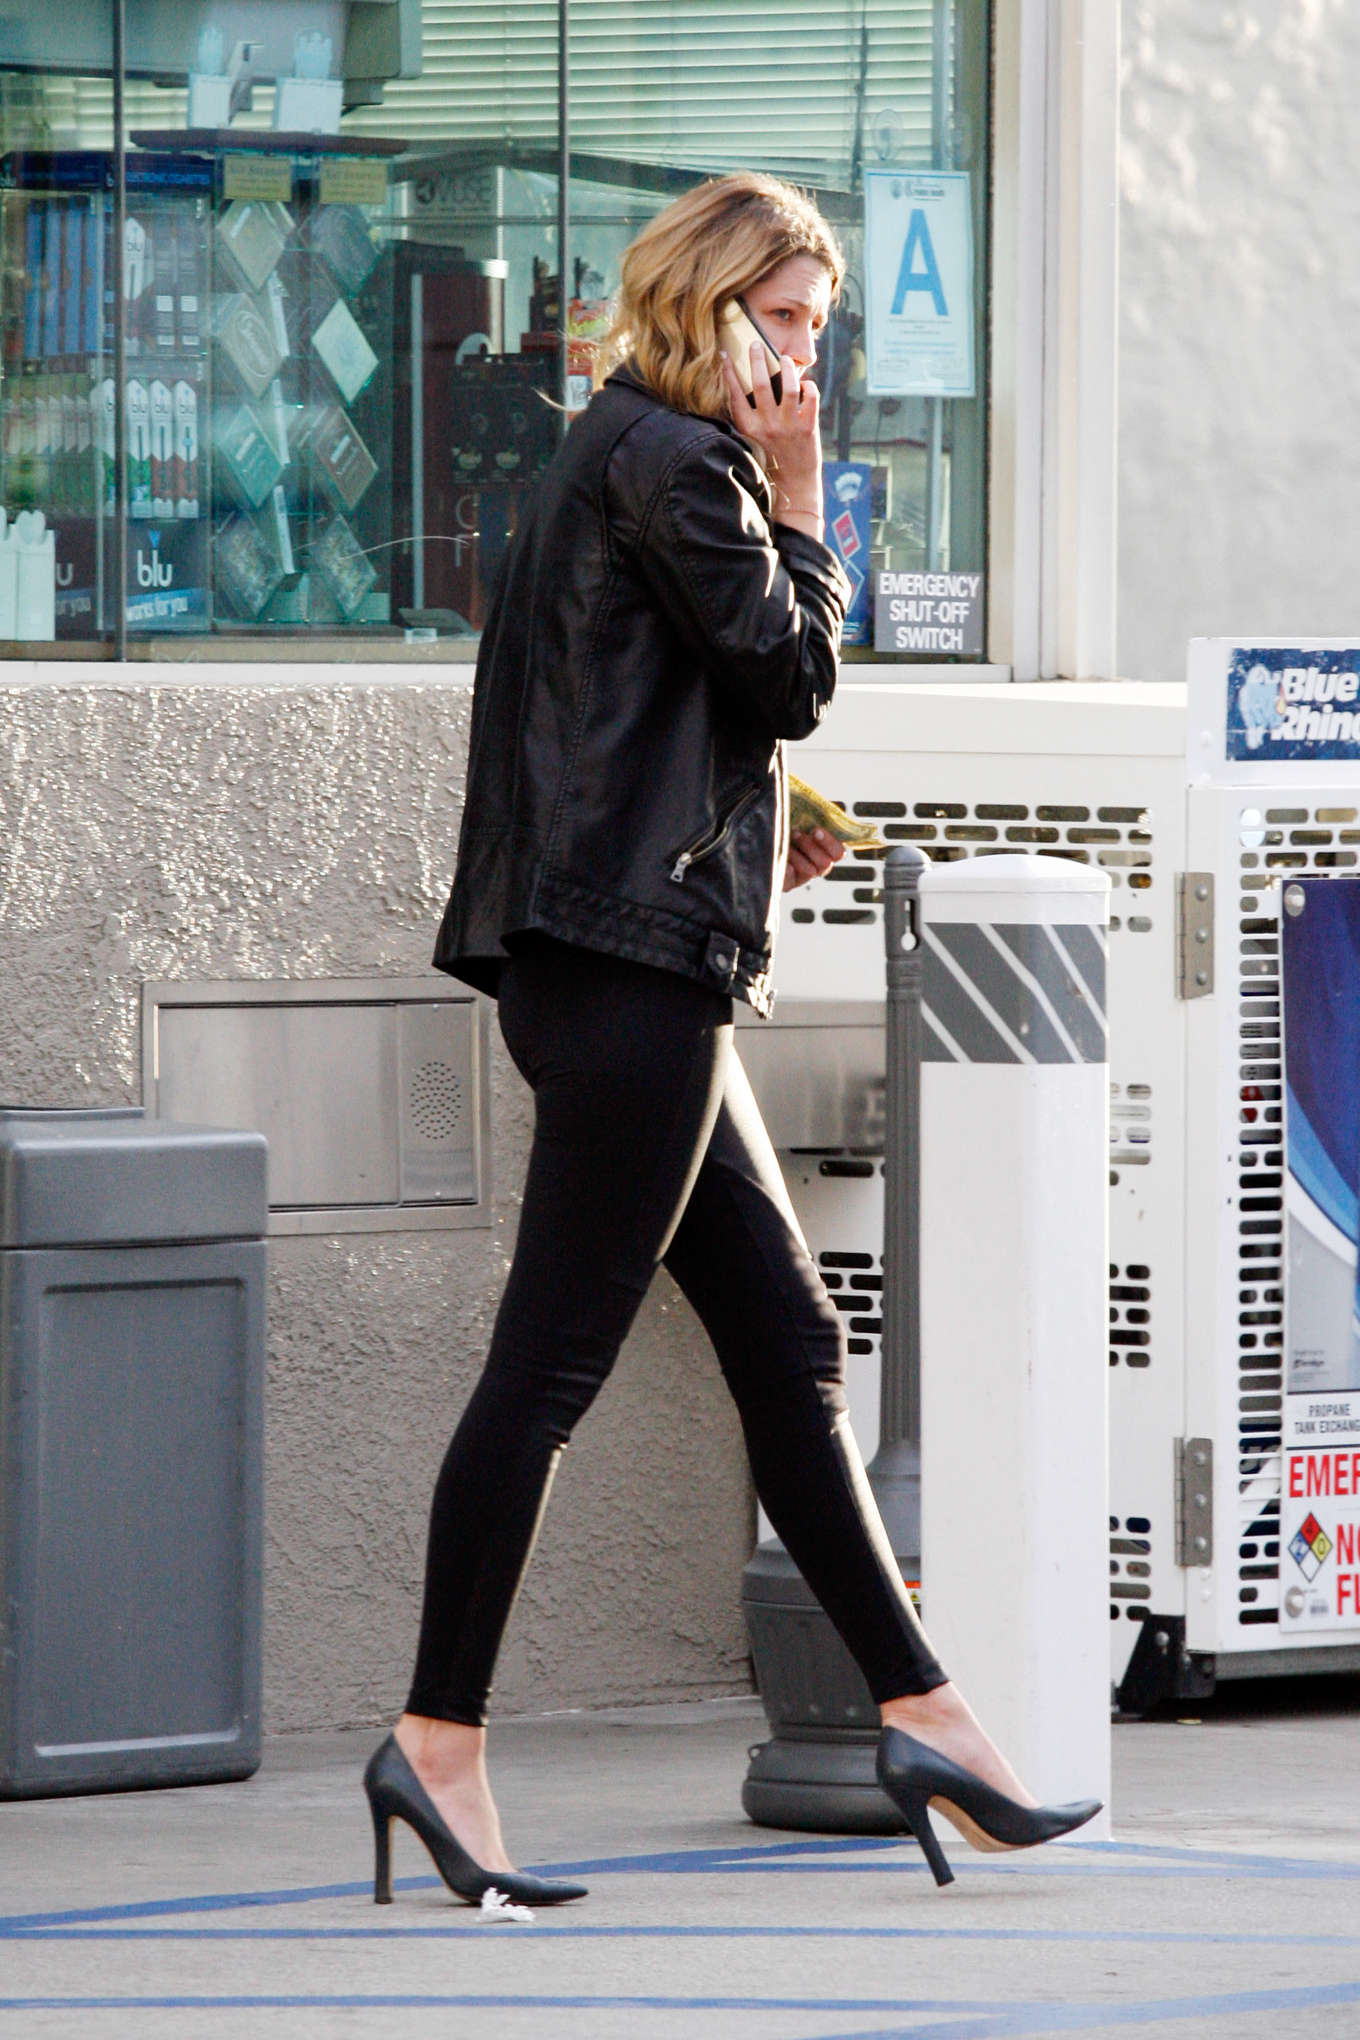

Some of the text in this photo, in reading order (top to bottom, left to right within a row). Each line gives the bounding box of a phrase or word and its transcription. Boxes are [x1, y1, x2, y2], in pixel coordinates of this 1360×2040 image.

[890, 209, 949, 316] A
[136, 549, 173, 587] blu
[879, 573, 980, 597] EMERGENCY
[889, 600, 970, 623] SHUT-OFF
[896, 626, 964, 651] SWITCH
[1282, 666, 1360, 703] Blue
[1308, 1403, 1351, 1417] PROPANE
[1294, 1421, 1315, 1434] TANK
